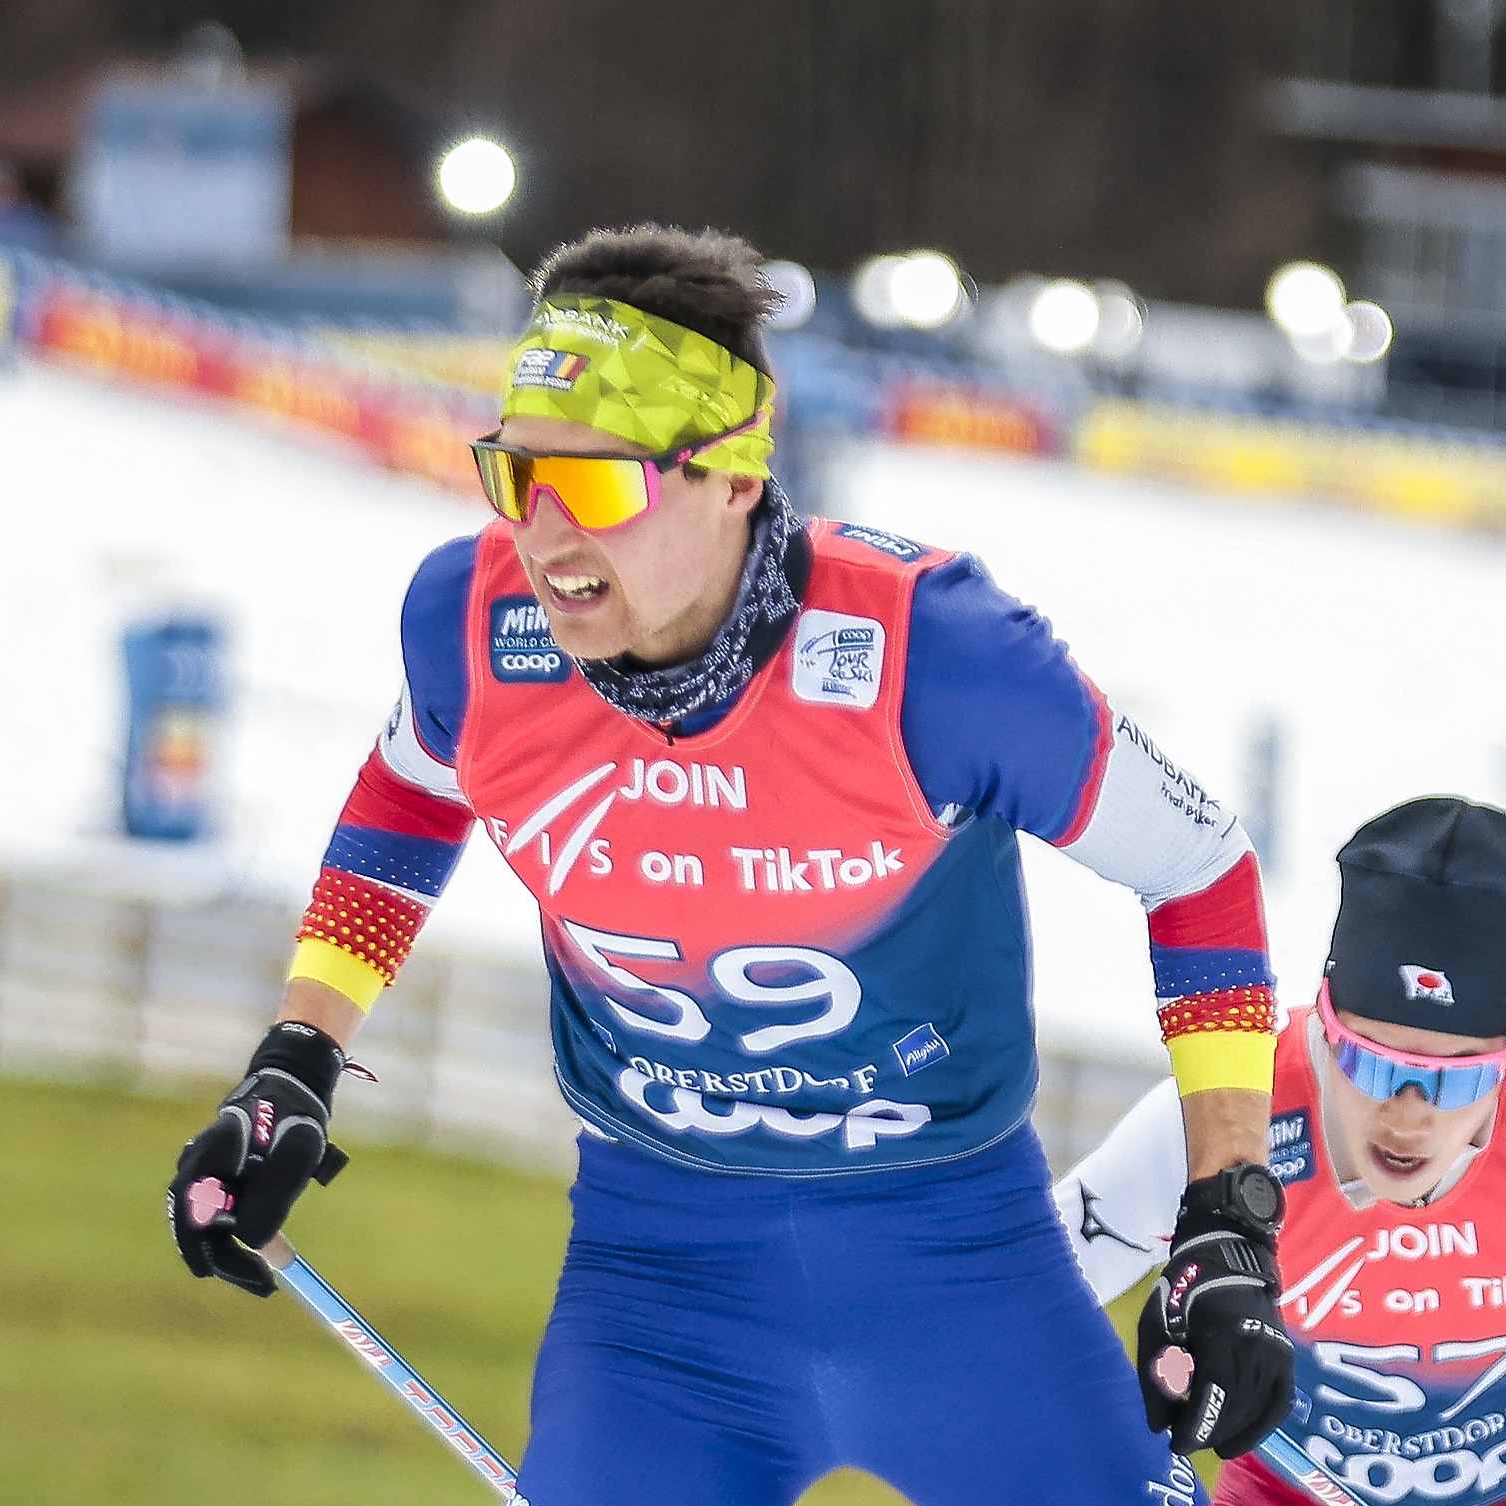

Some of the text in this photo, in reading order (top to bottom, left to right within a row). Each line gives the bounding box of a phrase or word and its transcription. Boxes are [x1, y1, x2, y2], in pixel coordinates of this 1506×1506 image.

[620, 759, 748, 809] JOIN
[641, 848, 705, 886] on
[732, 840, 906, 893] TikTok
[561, 918, 863, 1053] 59
[1368, 1222, 1478, 1261] JOIN
[1385, 1287, 1440, 1314] on
